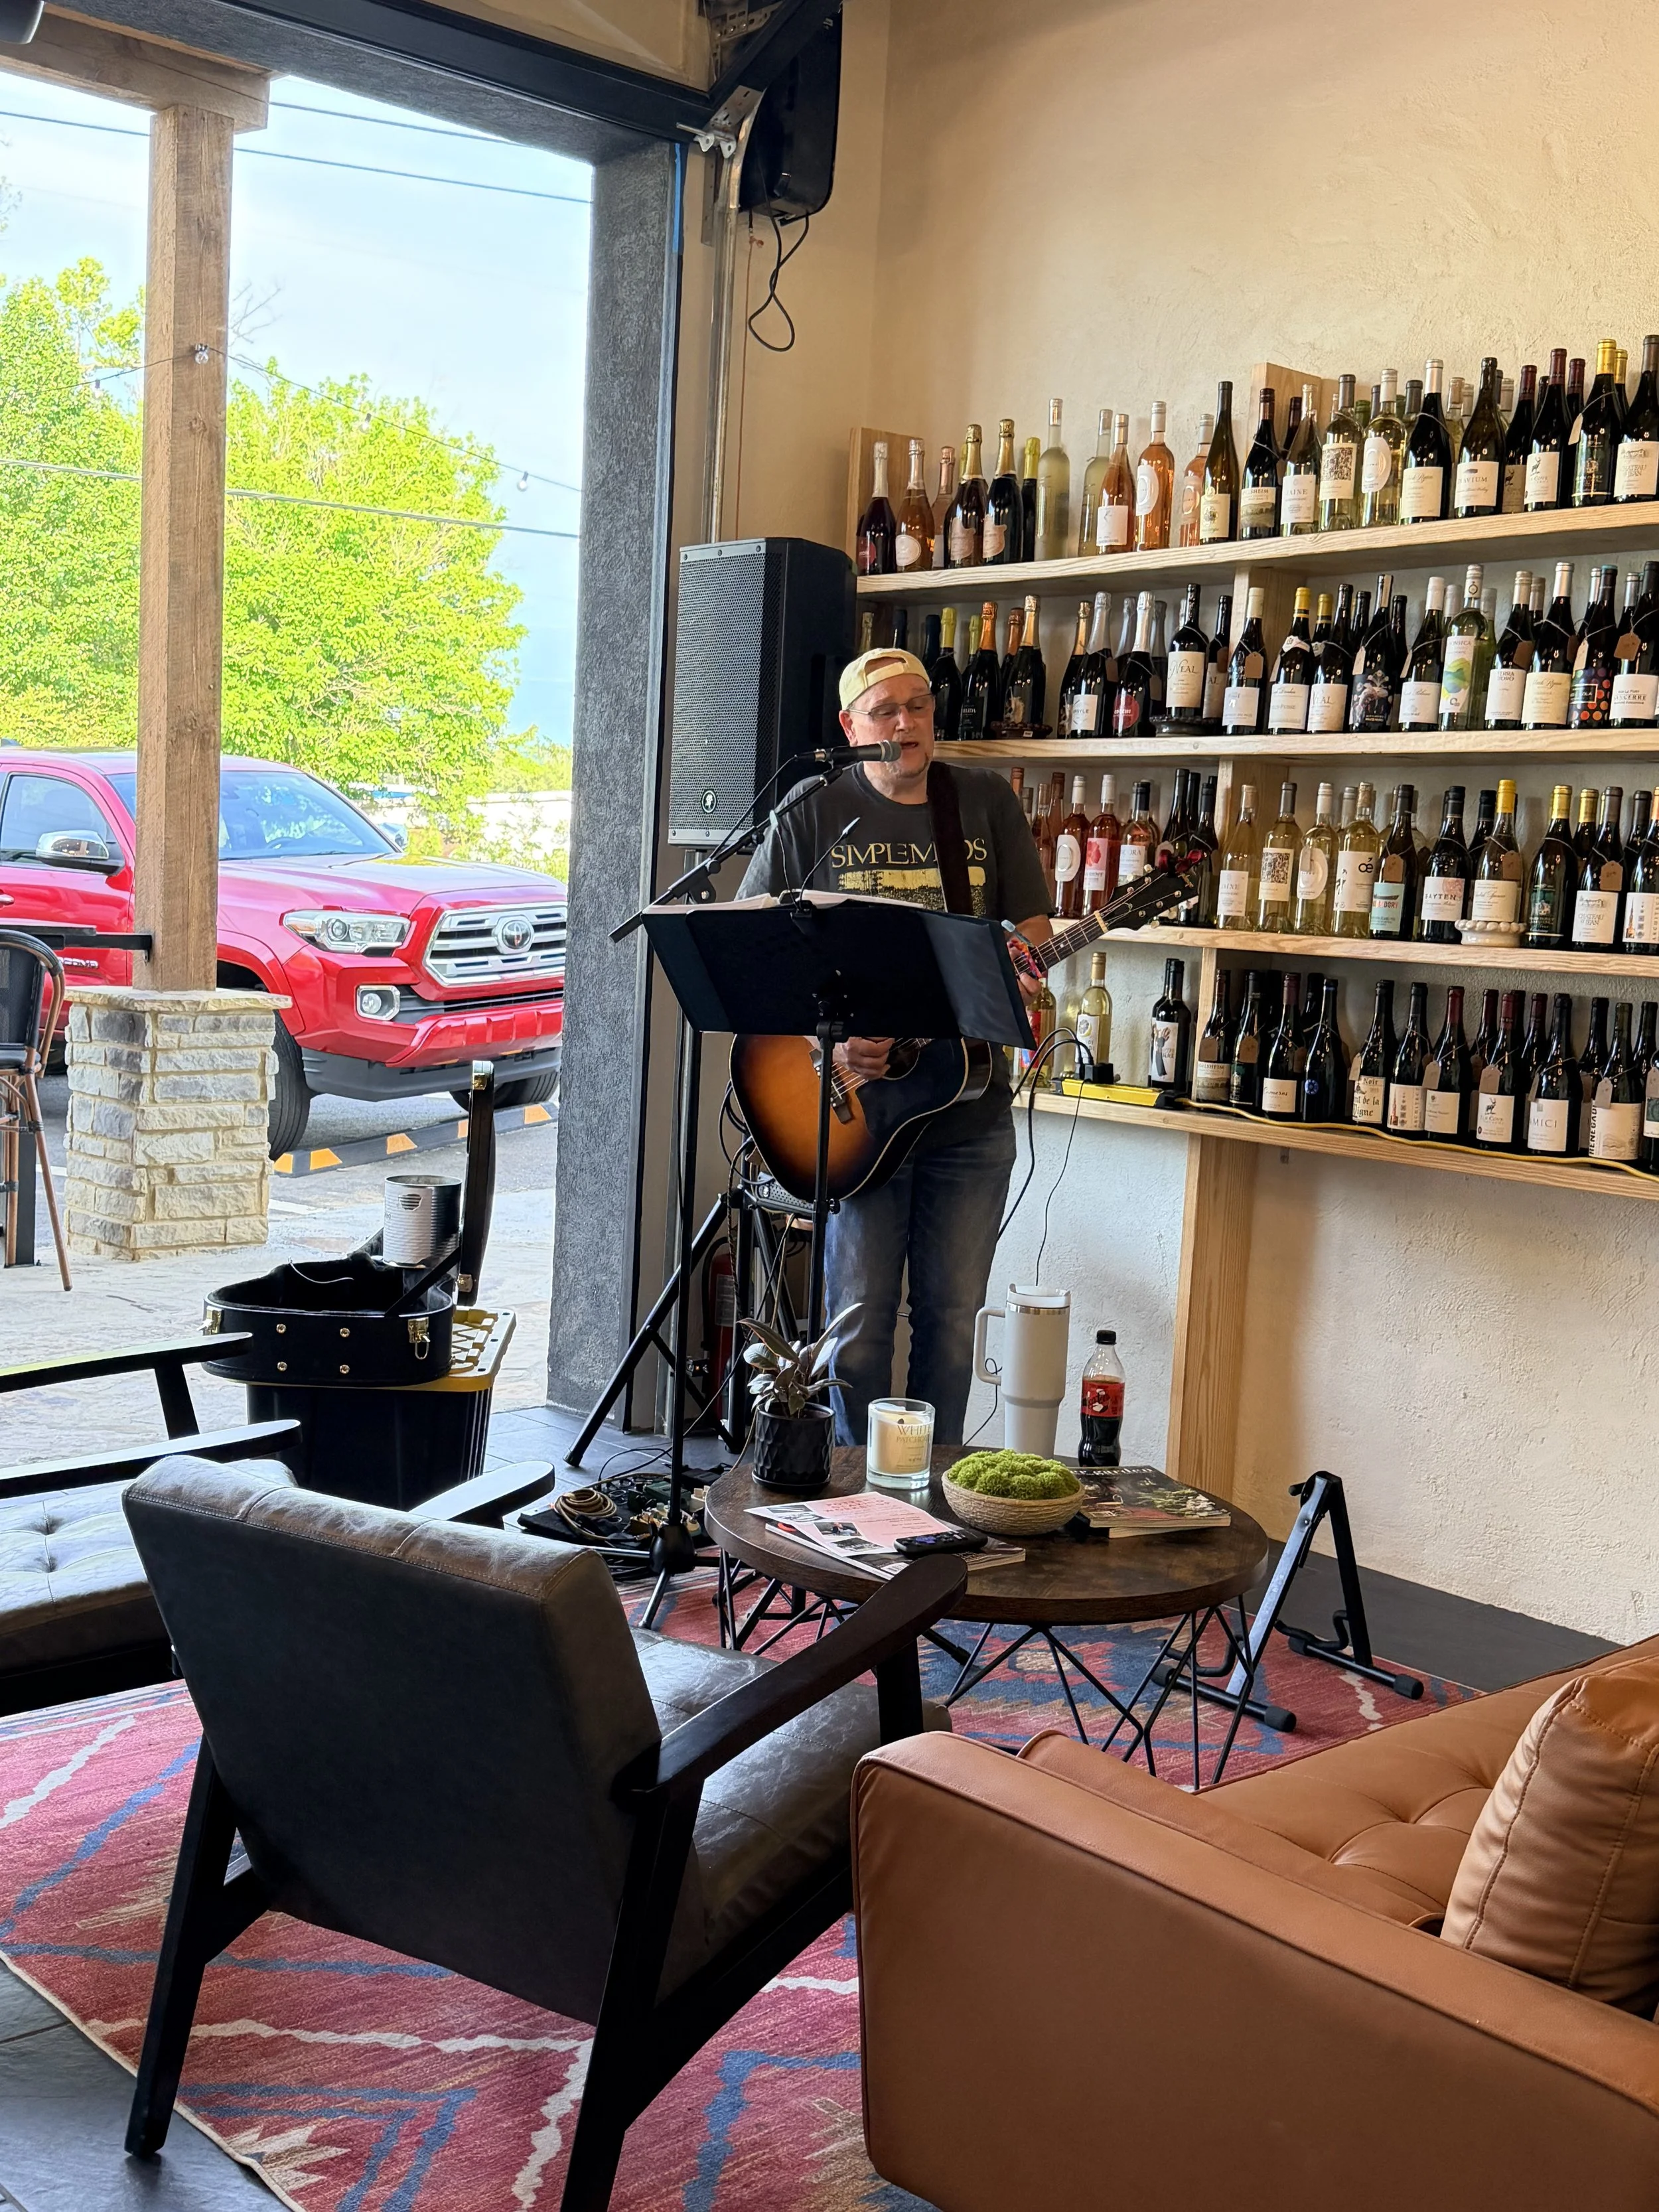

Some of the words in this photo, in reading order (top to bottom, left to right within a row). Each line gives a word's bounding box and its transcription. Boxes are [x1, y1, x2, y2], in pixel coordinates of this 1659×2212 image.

[1168, 659, 1198, 680] NEAL
[1208, 676, 1220, 685] AL
[1362, 1096, 1370, 1105] de
[1372, 1096, 1380, 1106] la
